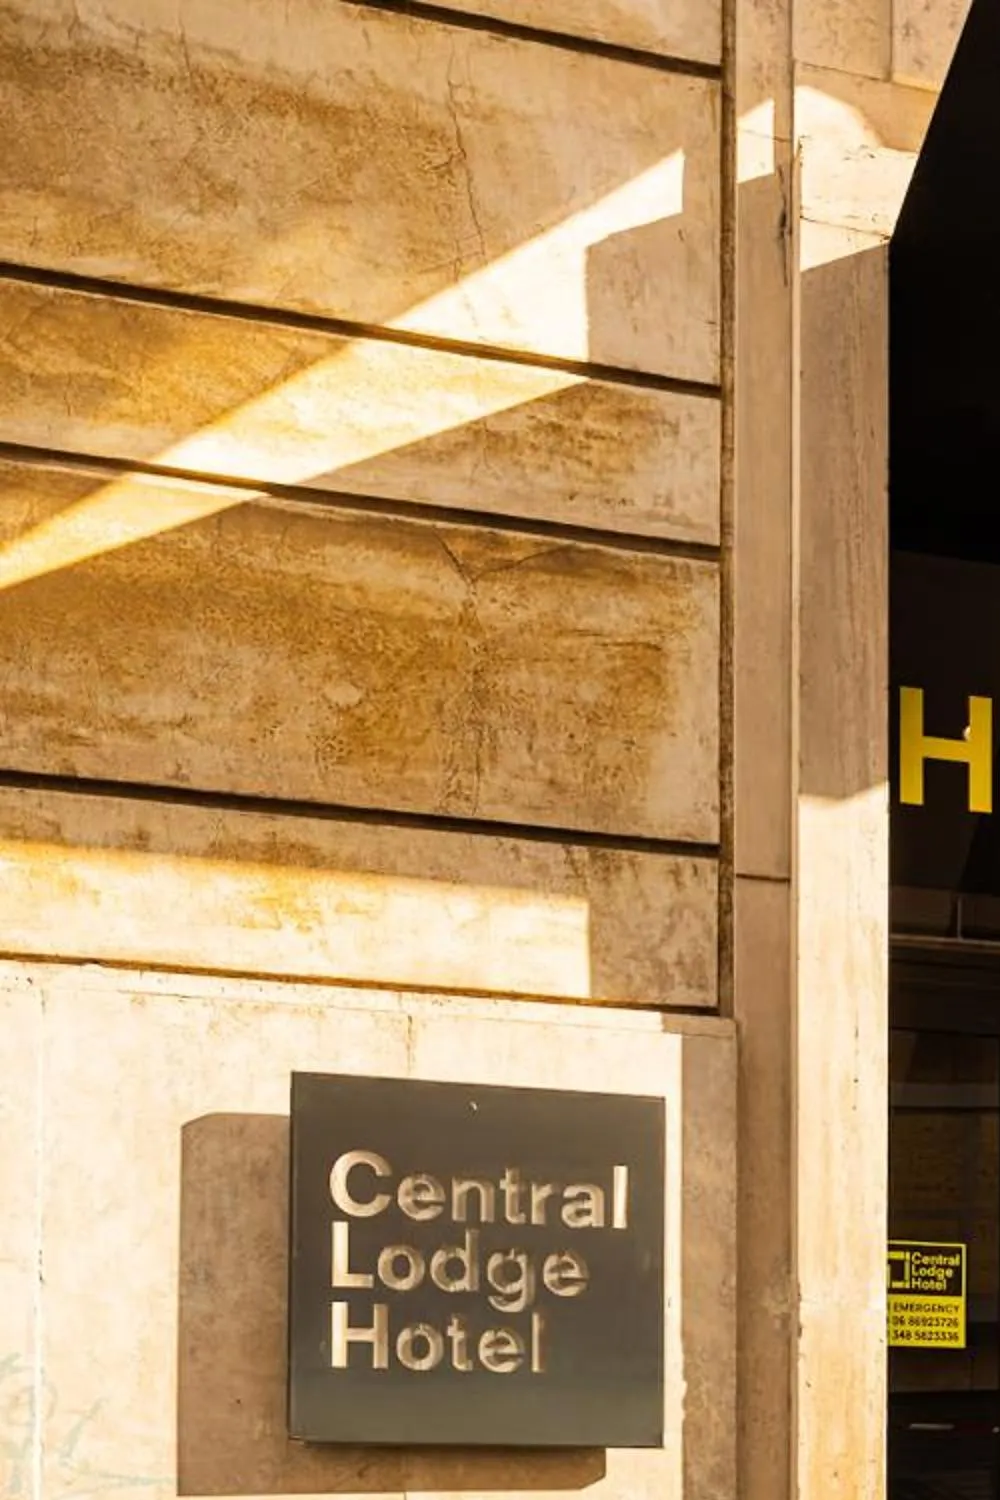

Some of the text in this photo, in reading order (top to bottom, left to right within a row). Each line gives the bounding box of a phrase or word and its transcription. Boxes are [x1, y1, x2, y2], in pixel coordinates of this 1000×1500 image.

[329, 1149, 629, 1229] Central
[911, 1251, 961, 1266] Central
[331, 1220, 590, 1313] Lodge
[911, 1265, 954, 1280] Lodge
[911, 1277, 947, 1291] Hotel
[893, 1302, 960, 1313] EMERGENCY
[330, 1301, 545, 1373] Hotel
